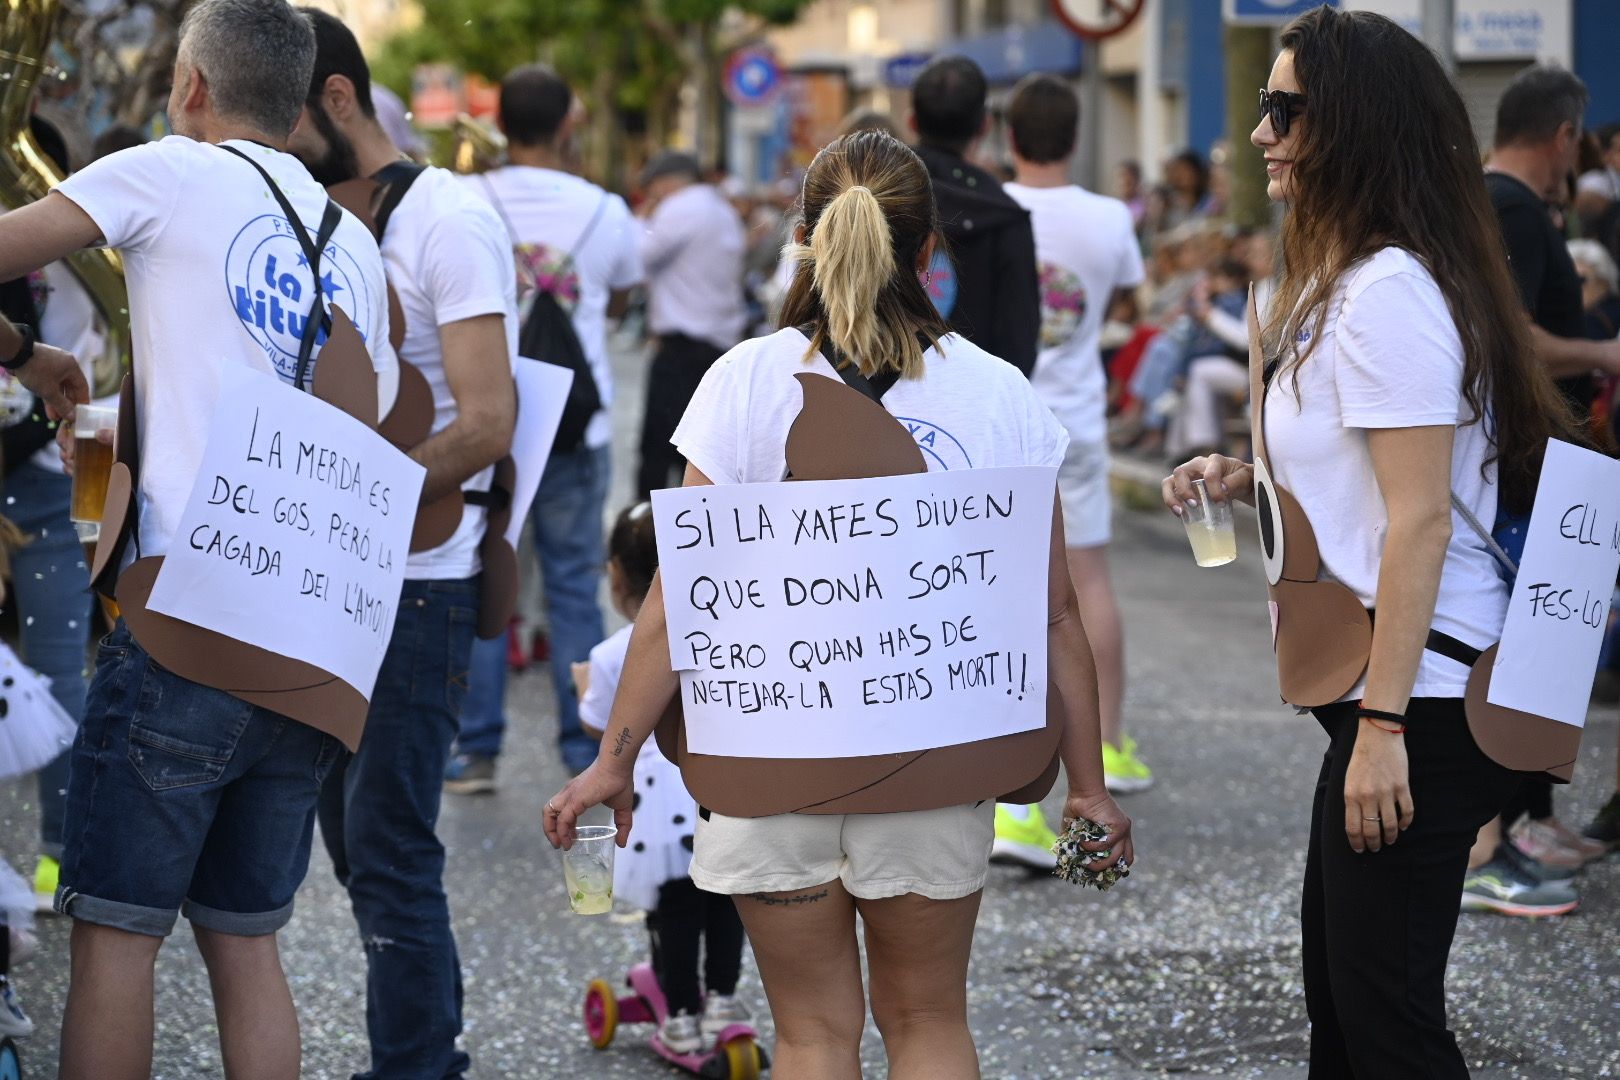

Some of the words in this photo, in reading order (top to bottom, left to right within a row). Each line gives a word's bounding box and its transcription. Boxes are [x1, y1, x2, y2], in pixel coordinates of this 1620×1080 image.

[247, 407, 282, 469] LA
[296, 441, 361, 498] MERDA
[369, 480, 391, 516] ES
[189, 524, 282, 577] CAGADA
[207, 475, 260, 514] DEL
[273, 497, 316, 537] GOS,
[328, 513, 370, 562] PERÓ
[378, 542, 393, 574] LA
[733, 504, 775, 542] LA
[791, 498, 899, 546] XAFES
[690, 575, 765, 620] QUE
[783, 566, 883, 606] DONA
[908, 549, 997, 600] SORT,
[684, 631, 766, 669] PERO
[789, 635, 863, 672] QUAN
[879, 623, 932, 658] HAS
[941, 615, 978, 648] DE
[692, 680, 833, 714] NETEJAR-LA
[863, 667, 933, 706] ESTAS
